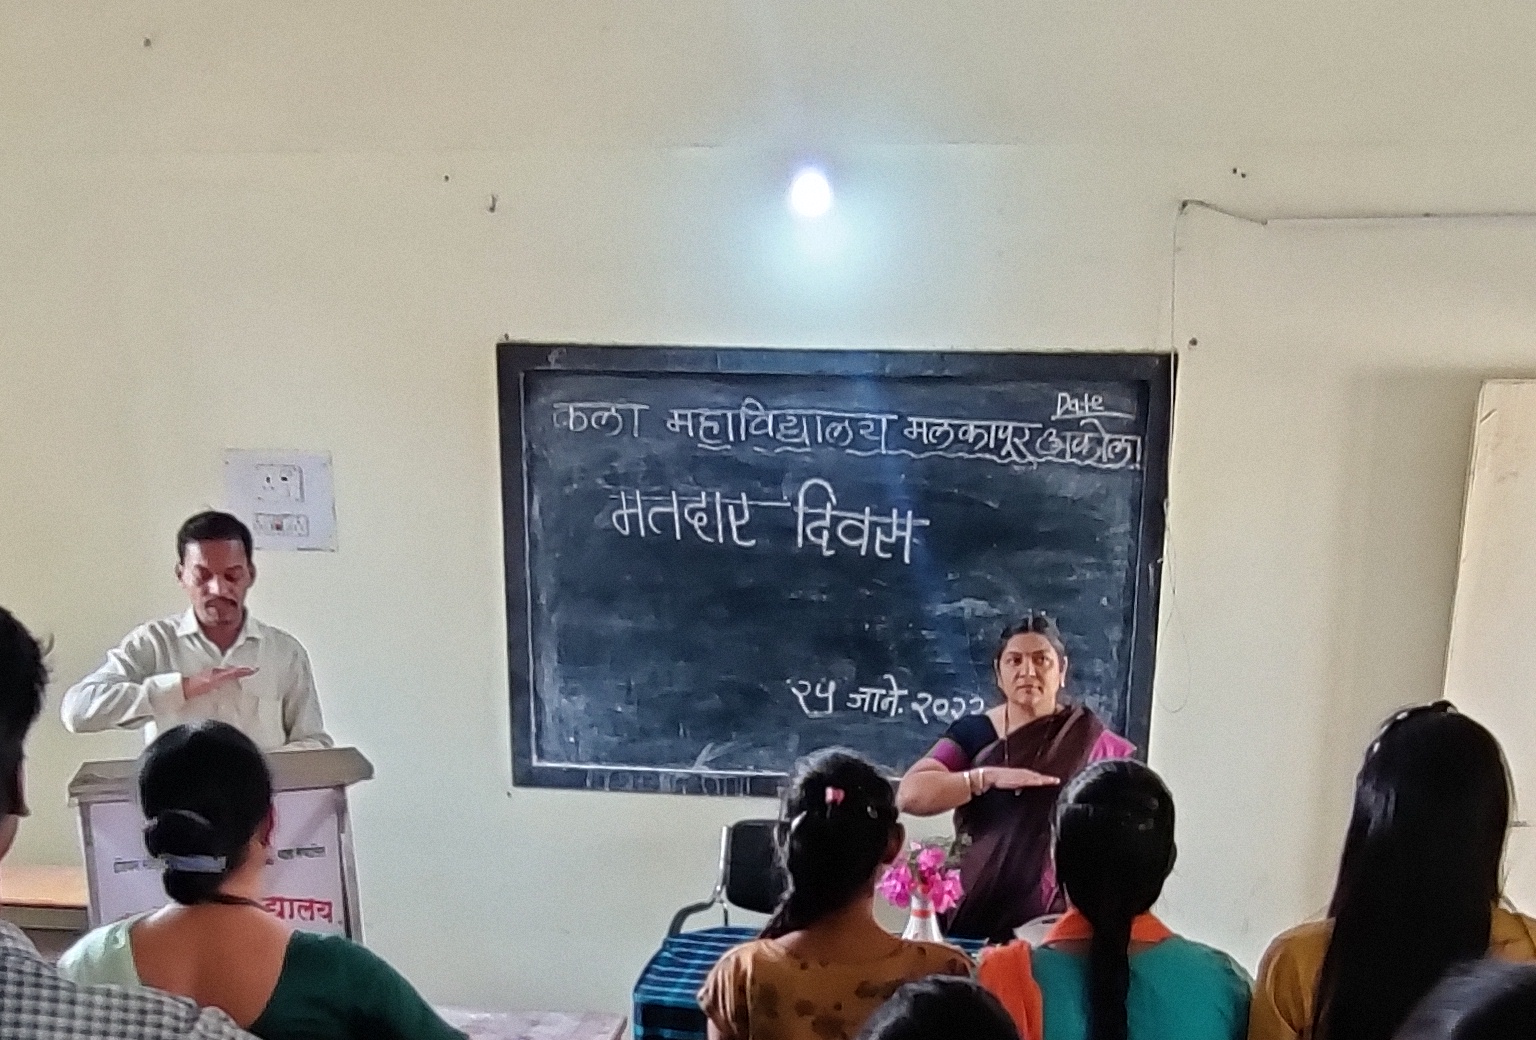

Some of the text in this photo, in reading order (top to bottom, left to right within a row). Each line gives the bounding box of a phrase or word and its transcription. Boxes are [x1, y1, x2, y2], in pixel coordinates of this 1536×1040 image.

[1056, 392, 1105, 416] Date
[553, 402, 650, 438] कला
[667, 397, 899, 454] महाविद्यालय
[1035, 417, 1142, 470] अकोला
[609, 478, 930, 564] मतदार दिवस
[790, 680, 836, 718] २५
